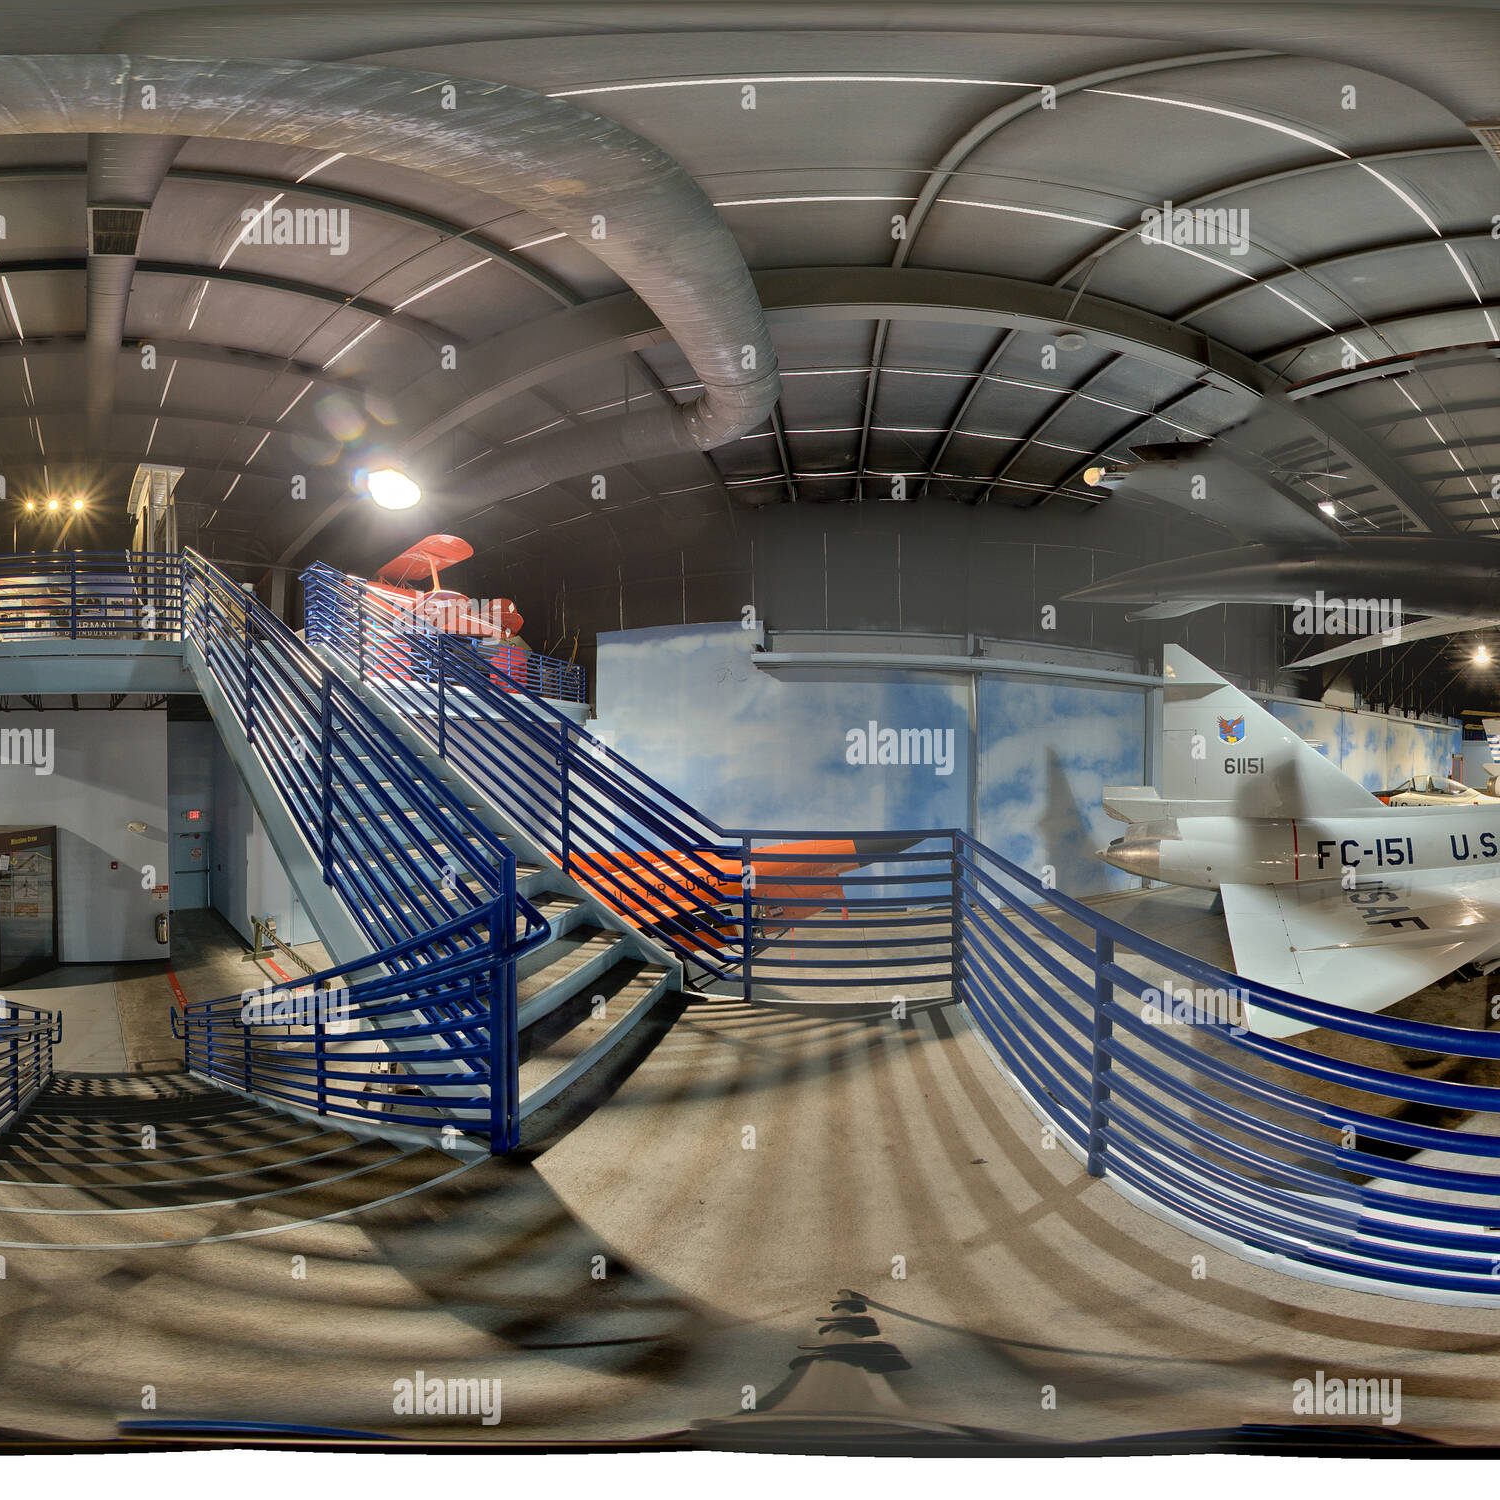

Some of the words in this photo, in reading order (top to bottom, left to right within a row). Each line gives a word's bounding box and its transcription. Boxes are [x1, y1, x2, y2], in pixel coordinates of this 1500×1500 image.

[1224, 757, 1264, 774] 61151
[188, 811, 200, 819] EXIT
[1317, 837, 1414, 869] FC-151
